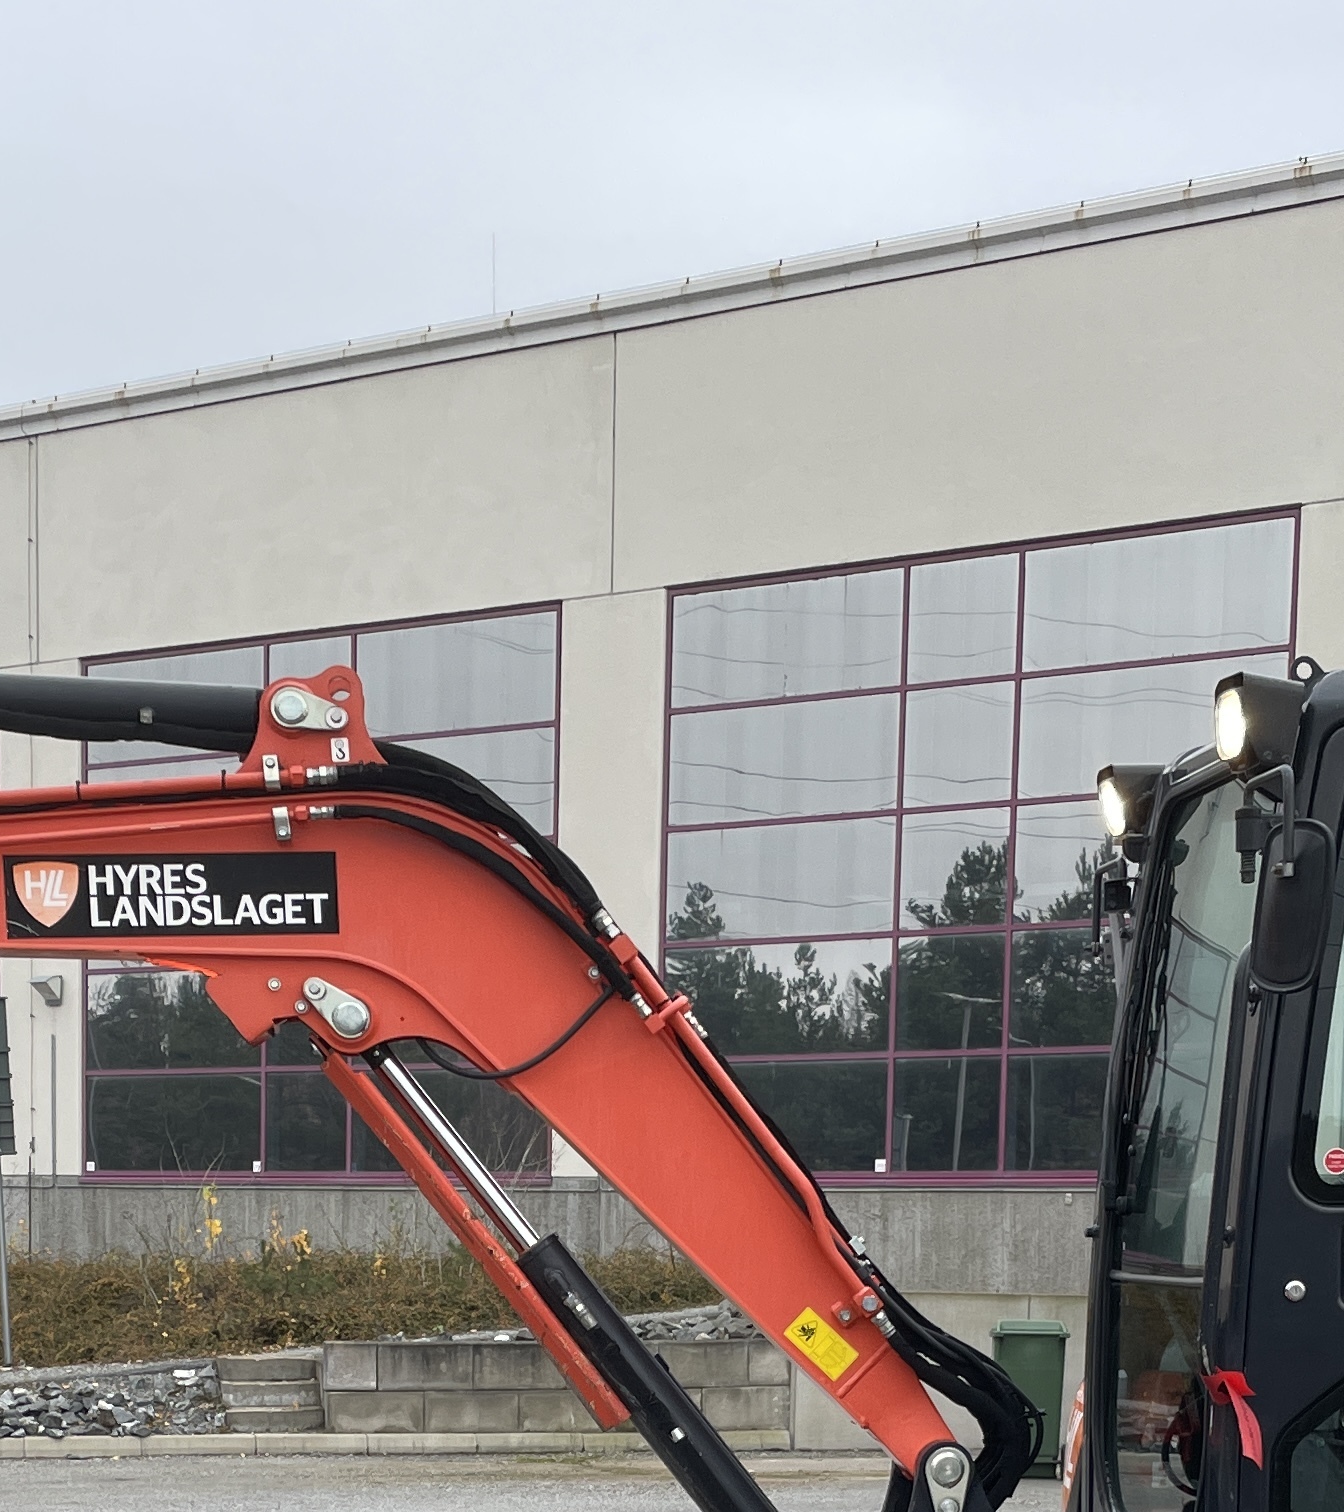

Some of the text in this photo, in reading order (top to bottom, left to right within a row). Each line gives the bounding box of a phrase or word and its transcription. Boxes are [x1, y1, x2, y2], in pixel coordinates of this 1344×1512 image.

[24, 869, 68, 907] HLL
[88, 864, 207, 896] HYRES
[89, 892, 328, 928] LANDSLAGET
